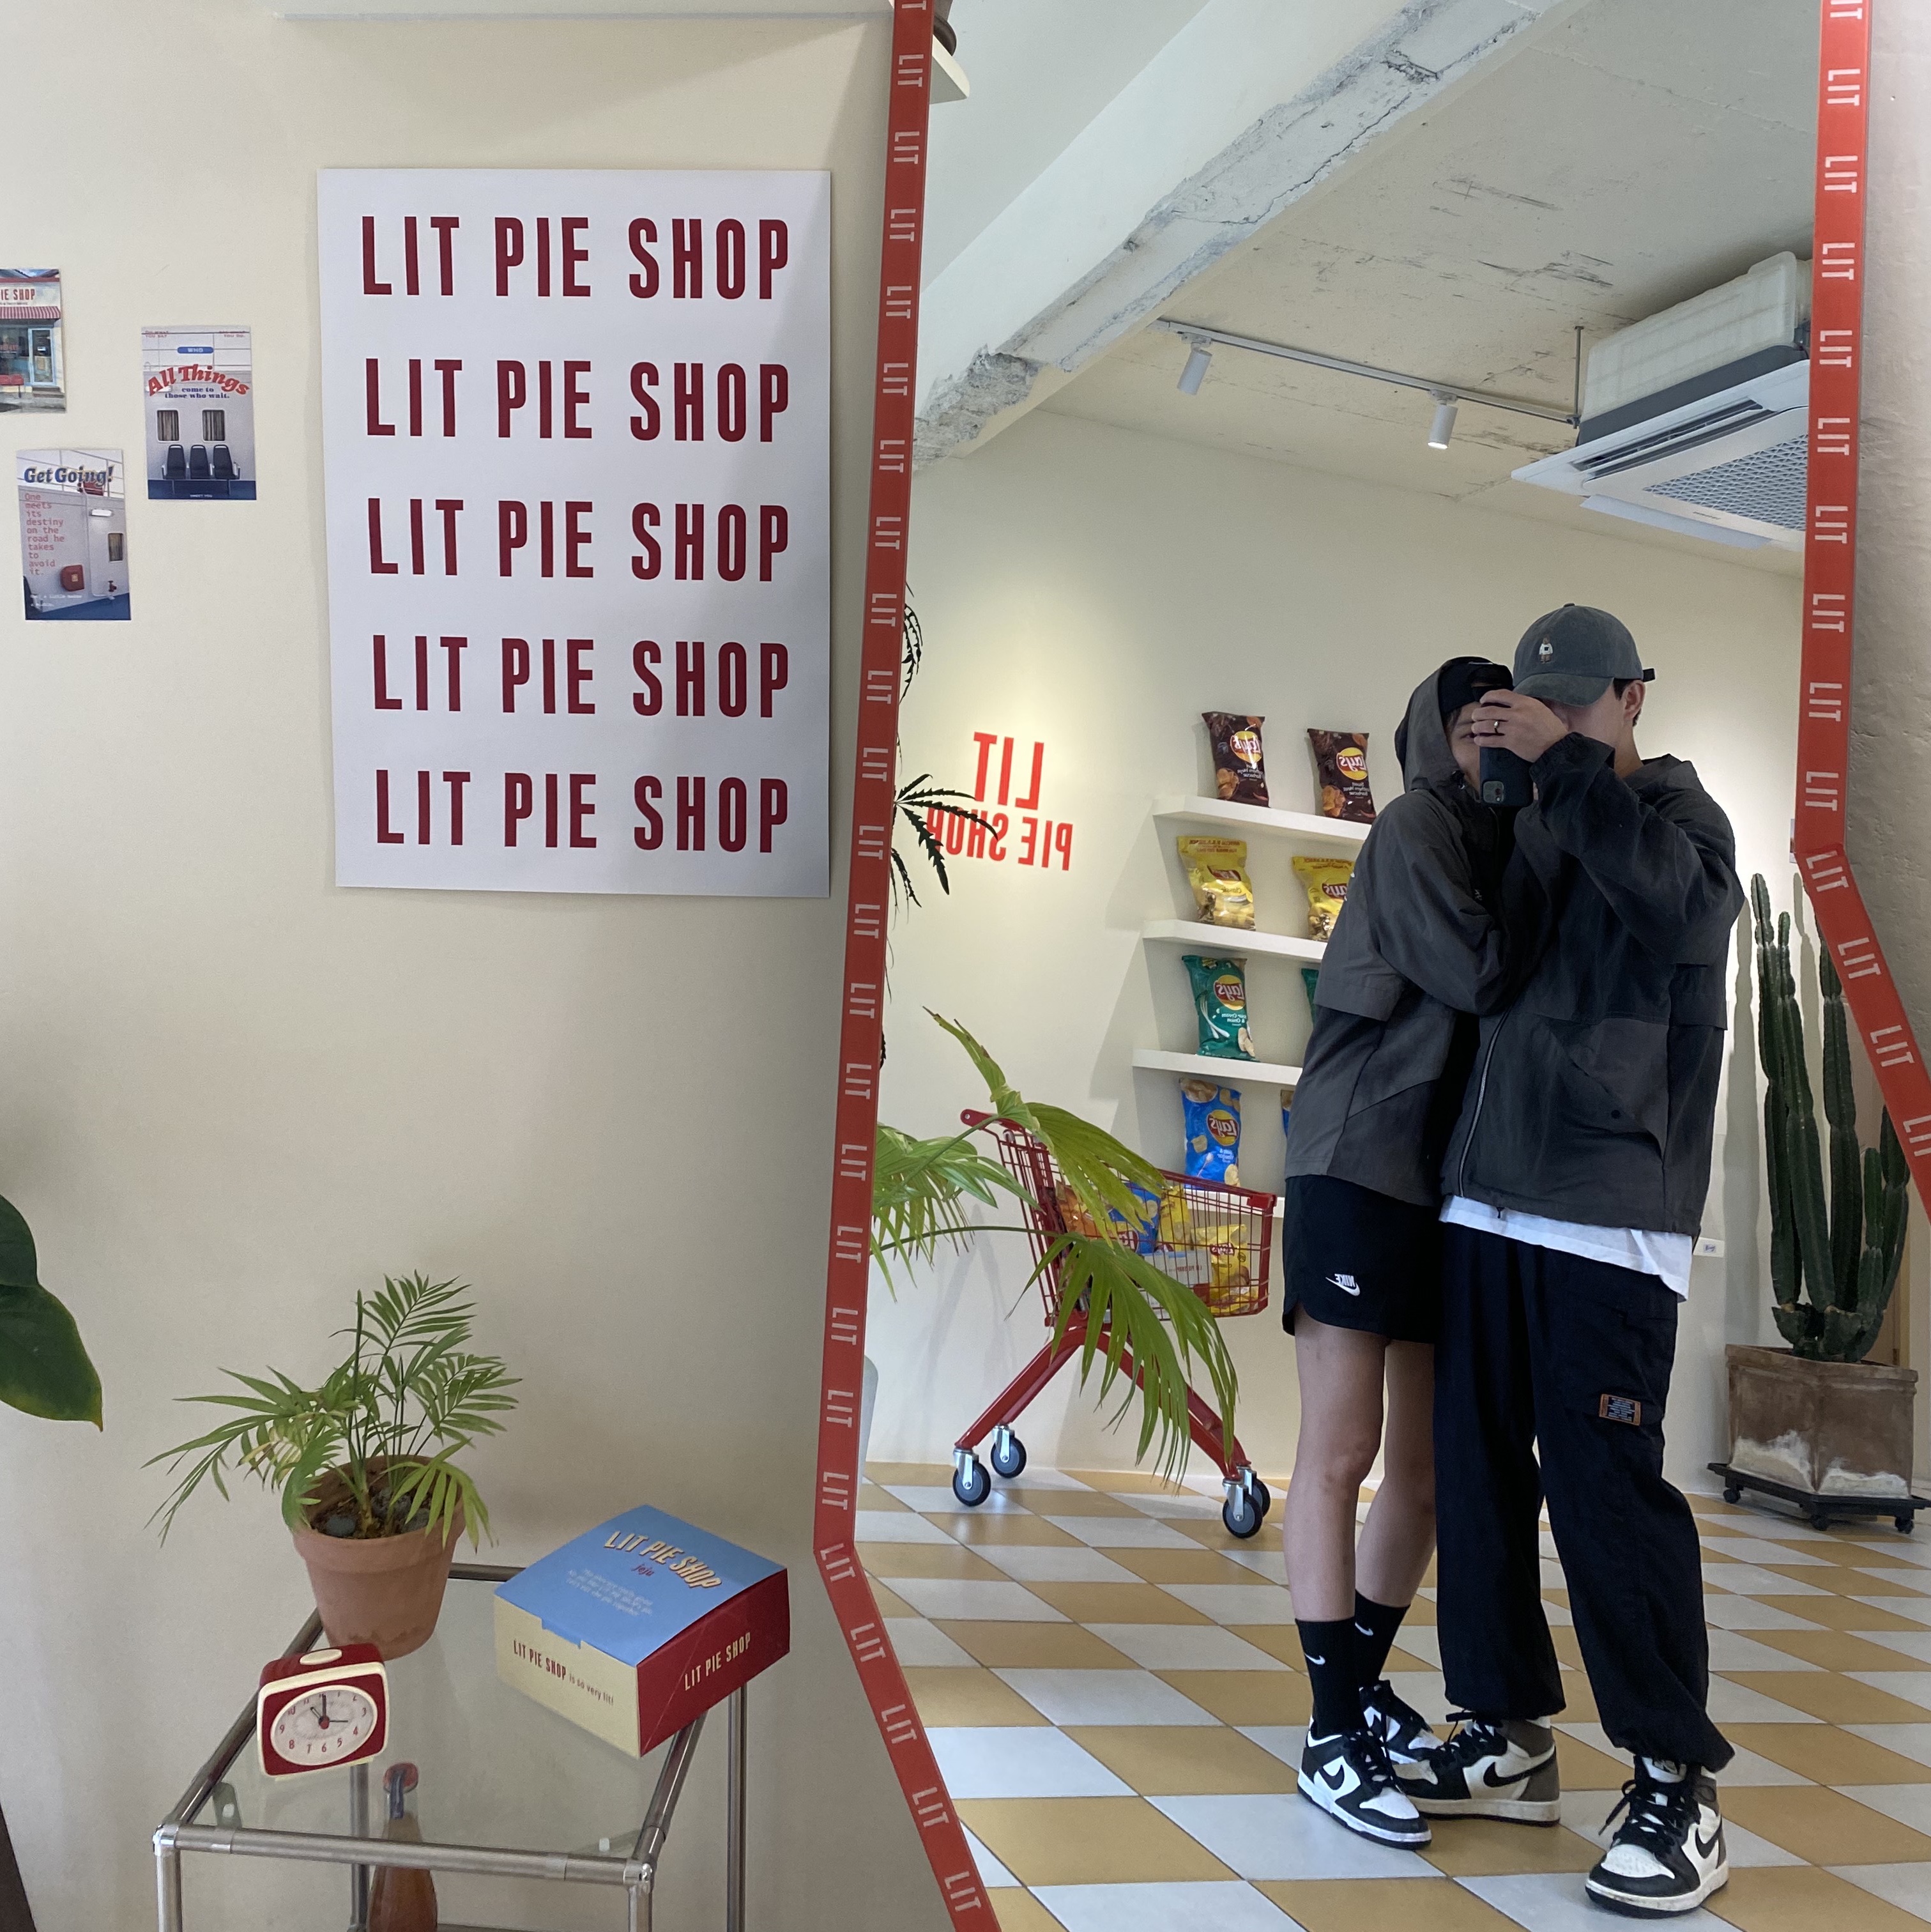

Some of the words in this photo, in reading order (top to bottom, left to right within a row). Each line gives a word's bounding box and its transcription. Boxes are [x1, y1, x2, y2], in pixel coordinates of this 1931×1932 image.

[1830, 0, 1862, 19] IT
[897, 54, 924, 88] LIT
[1827, 68, 1861, 107] LIT
[893, 131, 920, 165] LIT
[1824, 155, 1858, 194] LIT
[889, 208, 917, 242] LIT
[363, 217, 459, 296] LIT
[495, 218, 590, 297] PIE
[629, 218, 788, 300] SHOP
[1821, 242, 1855, 280] LIT
[0, 289, 8, 300] IE
[13, 289, 35, 300] SHOP
[885, 286, 912, 319] LIT
[1819, 330, 1853, 368] LIT
[148, 367, 176, 396] All
[178, 364, 250, 395] Things
[882, 362, 909, 396] LIT
[367, 359, 461, 436] LIT
[498, 360, 592, 438] PIE
[630, 362, 788, 442] SHOP
[1817, 417, 1851, 456] LIT
[24, 466, 54, 483] Get
[55, 464, 115, 487] Going!
[878, 440, 905, 473] LIT
[26, 518, 63, 526] destiny
[369, 498, 463, 575] LIT
[499, 501, 593, 578] PIE
[632, 503, 788, 581] SHOP
[874, 516, 902, 550] LIT
[1814, 505, 1849, 544] LIT
[870, 593, 897, 627] LIT
[1812, 593, 1845, 633] LIT
[374, 636, 468, 711] LIT
[503, 638, 595, 714] PIE
[633, 641, 788, 717] SHOP
[866, 670, 894, 705] LIT
[1808, 682, 1843, 722] LIT
[862, 747, 889, 782] LIT
[1805, 770, 1839, 811] LIT
[378, 770, 470, 845] LIT
[505, 773, 597, 848] PIE
[635, 776, 787, 852] SHOP
[857, 825, 885, 860] LIT
[1805, 850, 1849, 893] LIT
[853, 903, 881, 939] LIT
[1837, 937, 1881, 979] LIT
[849, 982, 876, 1019] LIT
[1870, 1024, 1915, 1068] LIT
[844, 1062, 872, 1100] LIT
[840, 1144, 867, 1181] LIT
[835, 1225, 864, 1264] LIT
[830, 1307, 859, 1346] LIT
[826, 1389, 854, 1428] LIT
[821, 1471, 850, 1510] LIT
[604, 1530, 649, 1552] LIT
[639, 1540, 685, 1565] PIE
[669, 1556, 722, 1588] SHOP
[820, 1543, 856, 1581] LIT
[850, 1622, 887, 1662] LIT
[514, 1639, 526, 1659] LIT
[530, 1648, 542, 1668] PIE
[546, 1657, 567, 1680] SHOP
[569, 1673, 575, 1684] is
[577, 1679, 584, 1689] so
[586, 1685, 601, 1701] very
[685, 1664, 701, 1691] LIT
[705, 1650, 722, 1677] PIE
[726, 1632, 751, 1662] SHOP
[279, 1724, 285, 1735] 9
[353, 1726, 358, 1735] 4
[362, 1707, 367, 1716] 3
[881, 1703, 917, 1744] LIT
[289, 1740, 295, 1749] 8
[307, 1744, 312, 1754] 7
[322, 1743, 327, 1752] 6
[337, 1738, 342, 1748] 5
[912, 1786, 949, 1827] LIT
[943, 1870, 982, 1912] LIT
